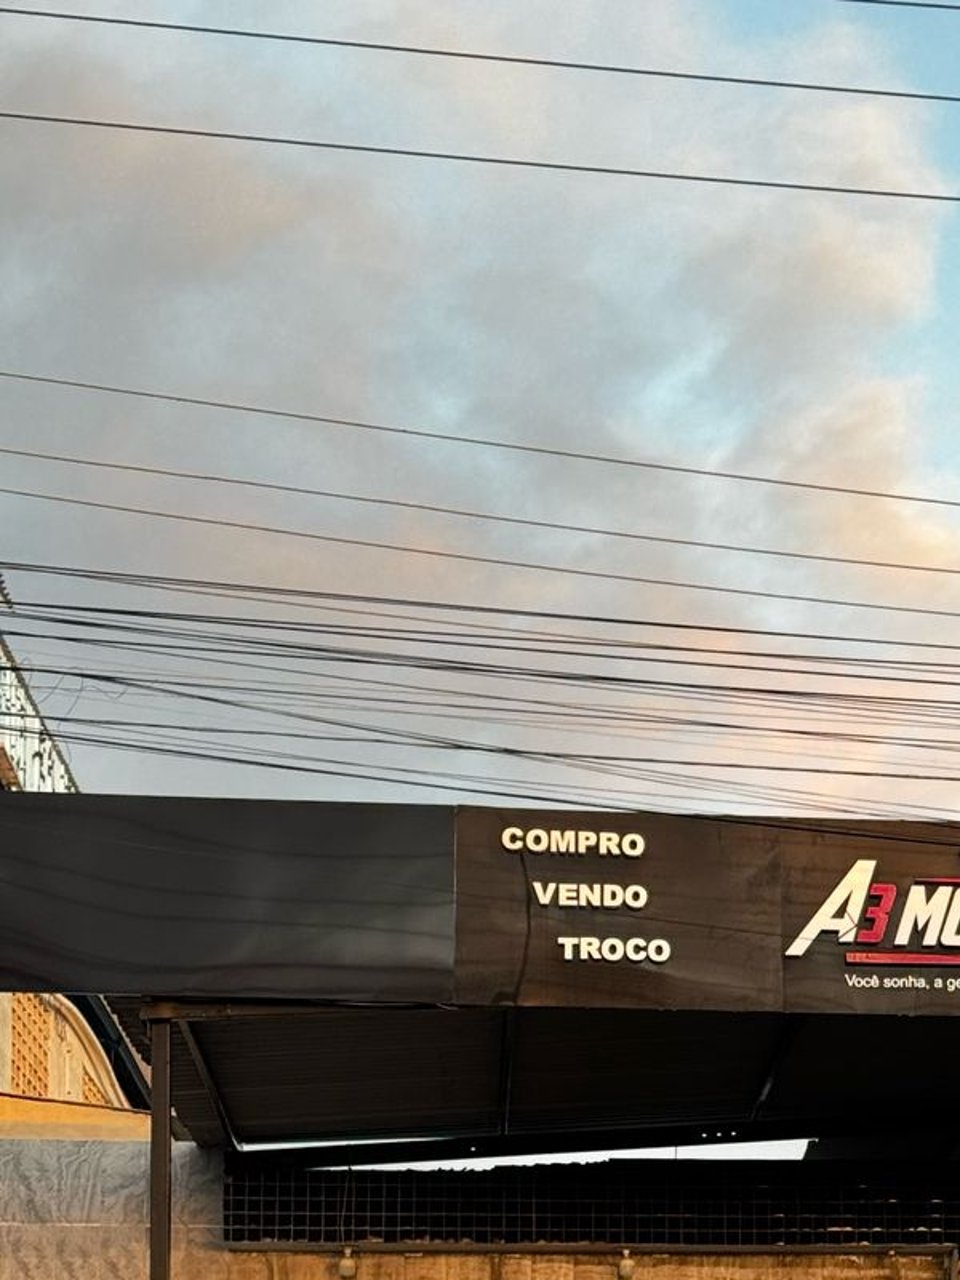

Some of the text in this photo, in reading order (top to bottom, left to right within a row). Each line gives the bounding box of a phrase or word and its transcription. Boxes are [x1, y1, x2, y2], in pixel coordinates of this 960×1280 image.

[501, 826, 646, 857] COMPRO
[532, 881, 648, 909] VENDO
[784, 858, 898, 957] A3
[557, 936, 672, 963] TROCO
[844, 973, 880, 989] Você
[883, 974, 931, 990] sonha,
[933, 978, 943, 989] a
